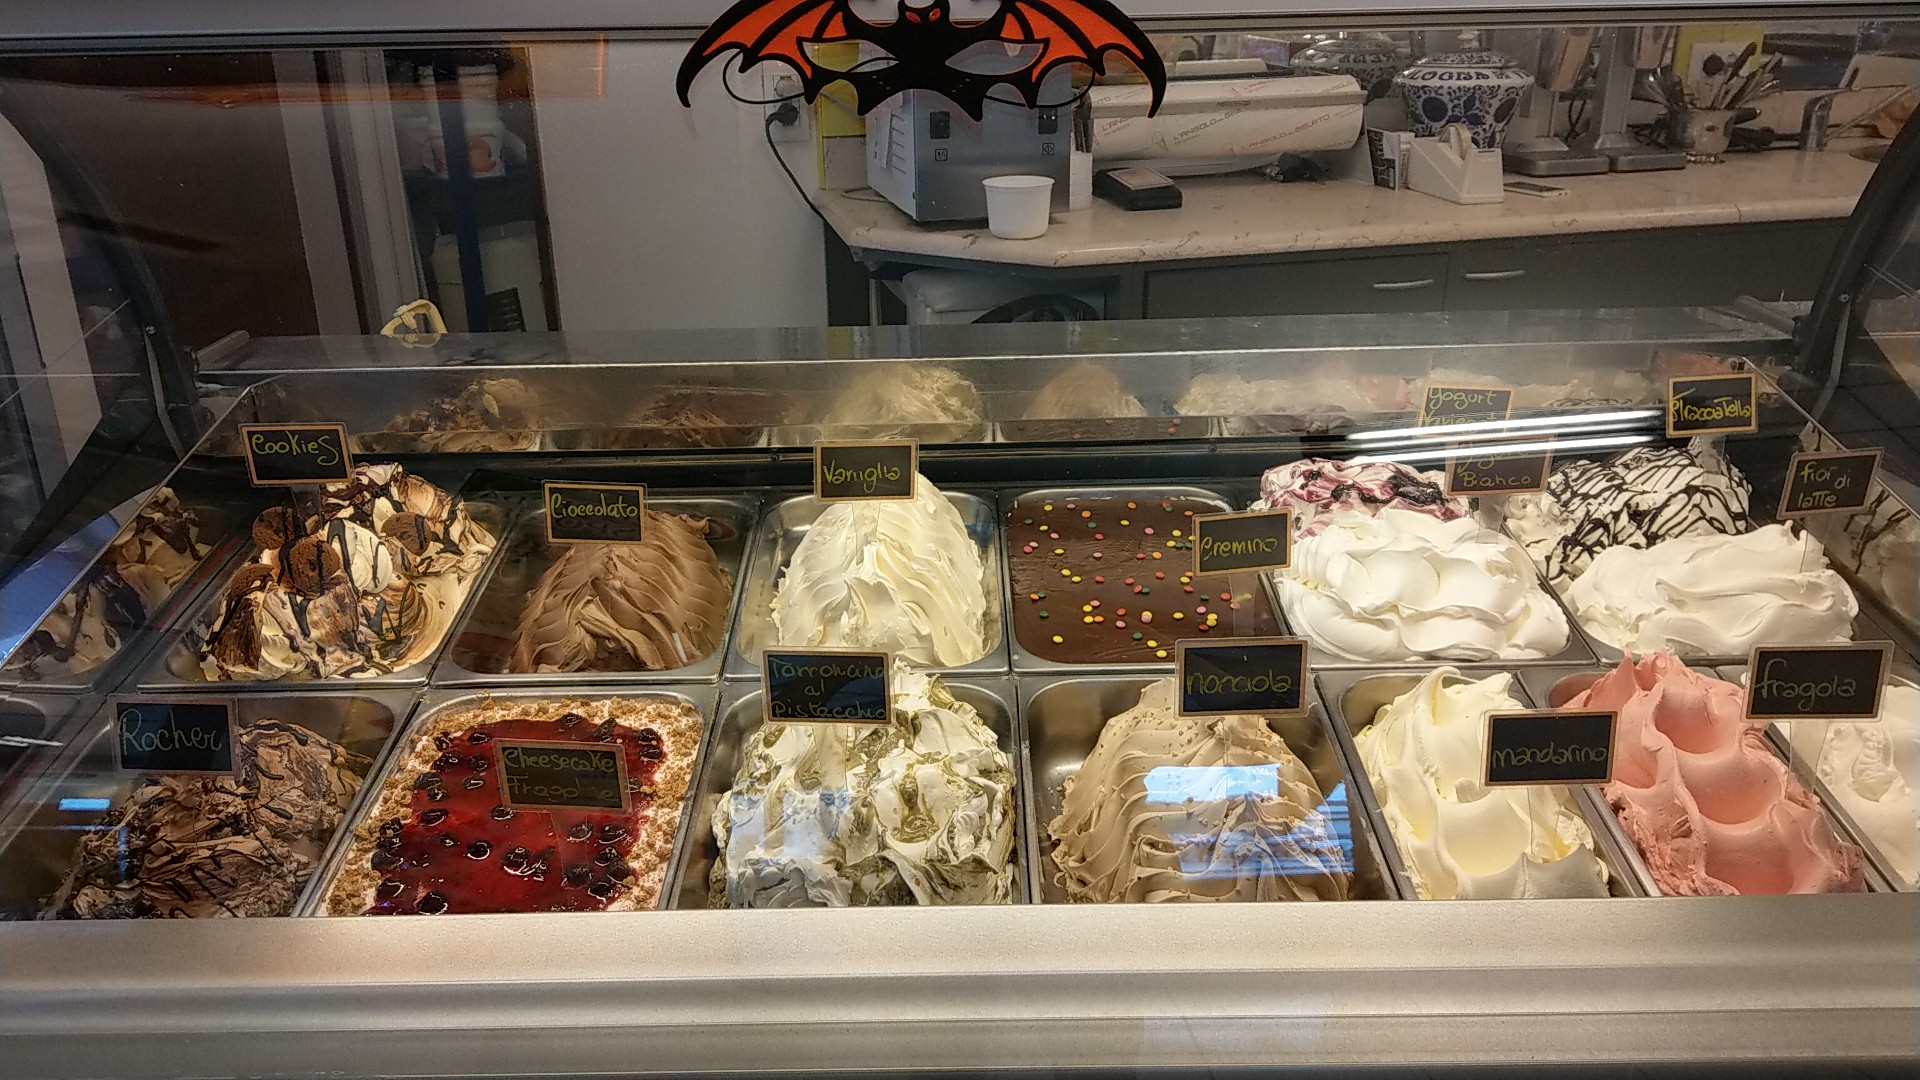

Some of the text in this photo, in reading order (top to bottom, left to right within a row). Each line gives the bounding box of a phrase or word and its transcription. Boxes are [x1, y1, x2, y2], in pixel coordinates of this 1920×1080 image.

[823, 459, 901, 494] Vaniglia
[1834, 469, 1851, 490] di
[551, 492, 639, 519] Cioccolato
[1200, 536, 1278, 561] Cremino
[804, 678, 825, 696] al
[771, 700, 885, 719] Pistacchio
[118, 708, 223, 756] Rocher
[503, 747, 616, 773] Cheesecake
